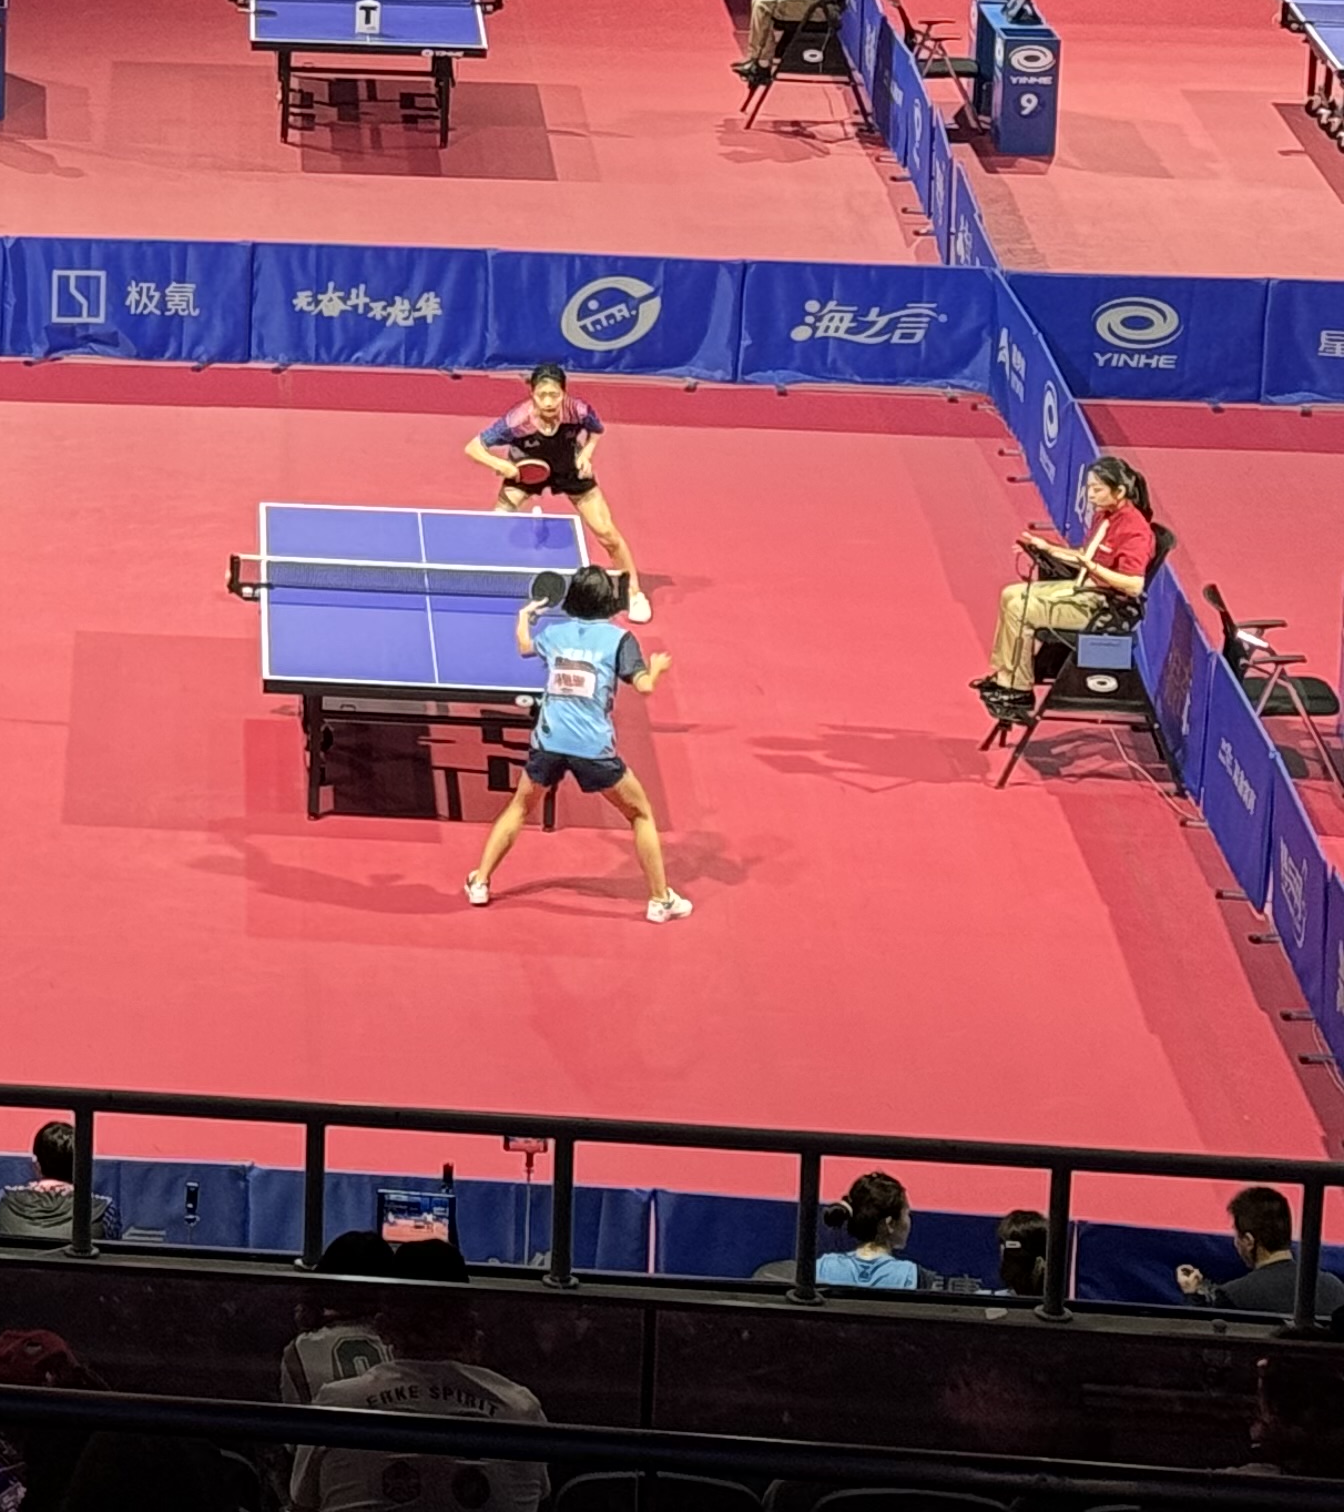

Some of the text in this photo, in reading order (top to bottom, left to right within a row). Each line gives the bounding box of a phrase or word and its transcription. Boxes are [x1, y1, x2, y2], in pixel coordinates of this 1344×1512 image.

[1019, 92, 1040, 117] 9
[125, 280, 201, 317] 极氪
[291, 280, 443, 328] 无奋斗不龙华
[790, 299, 940, 345] 海之言
[1092, 351, 1179, 370] YINHE
